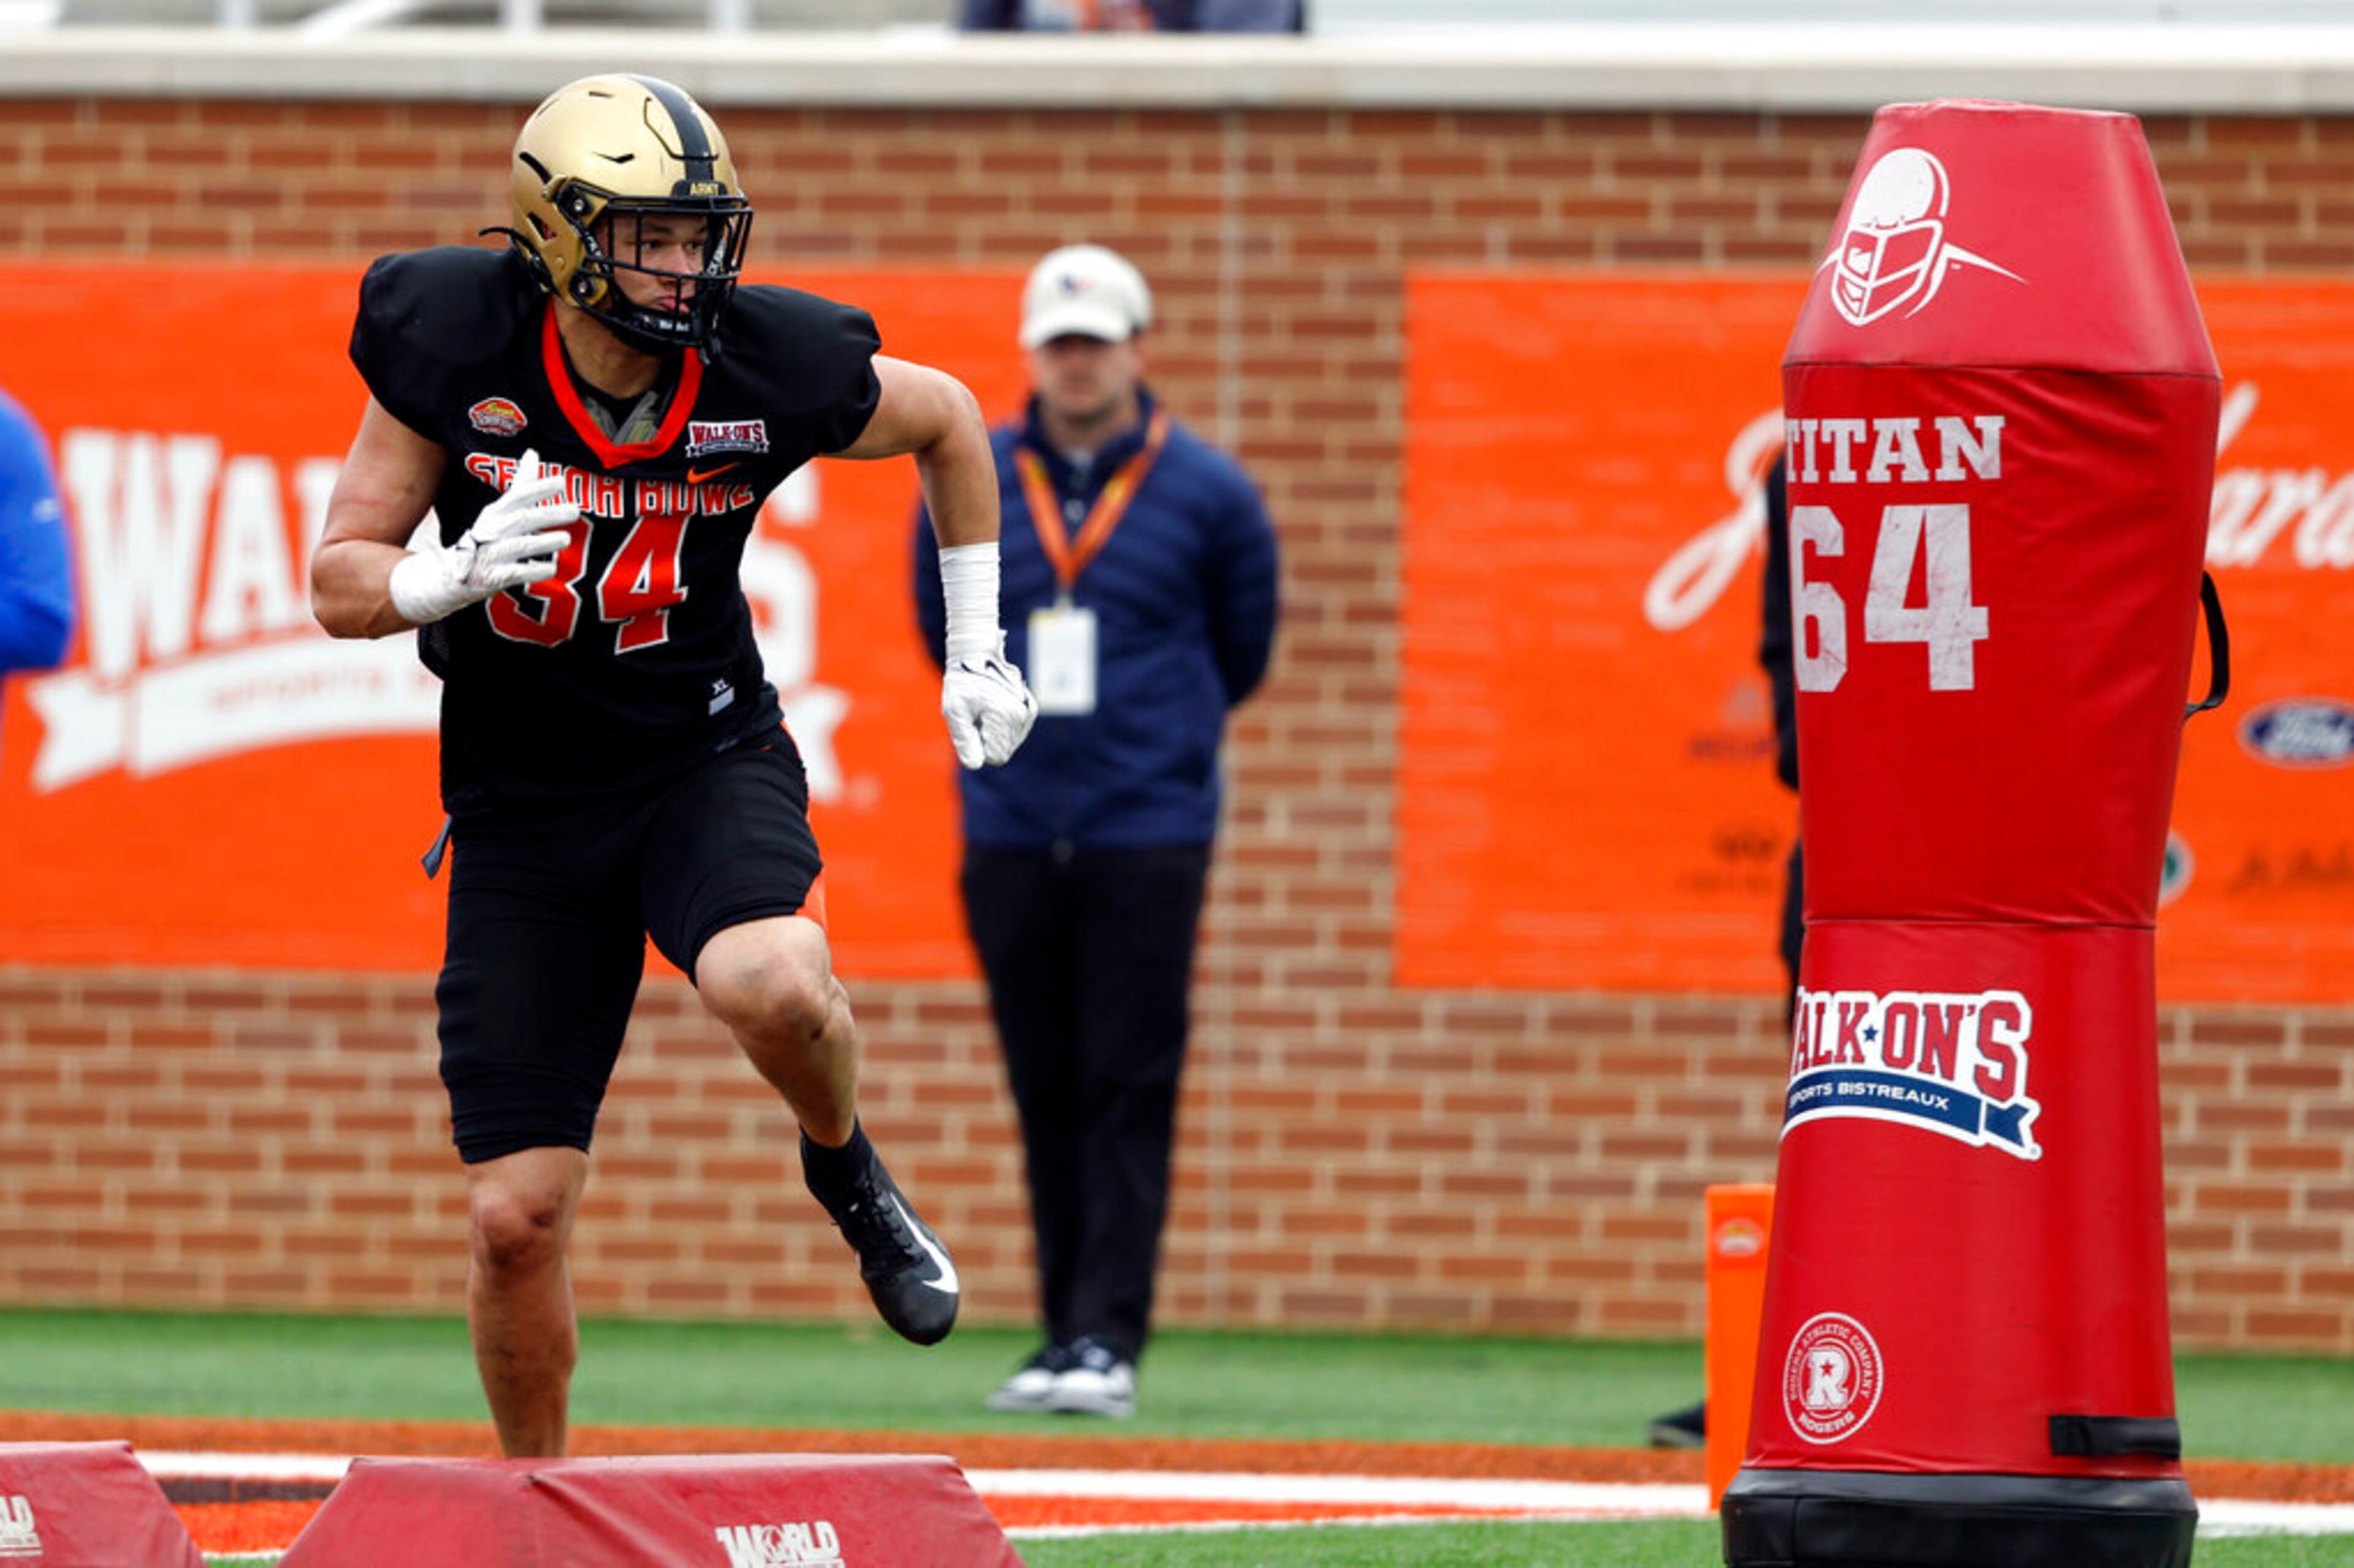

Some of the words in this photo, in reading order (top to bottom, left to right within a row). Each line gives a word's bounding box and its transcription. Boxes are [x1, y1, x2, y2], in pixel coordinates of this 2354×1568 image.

[1785, 415, 2005, 483] TITAN
[486, 514, 688, 655] 34
[1789, 503, 1989, 692] 64
[1838, 1082, 1949, 1111] BISTREAUX
[714, 1520, 842, 1567] WORLD
